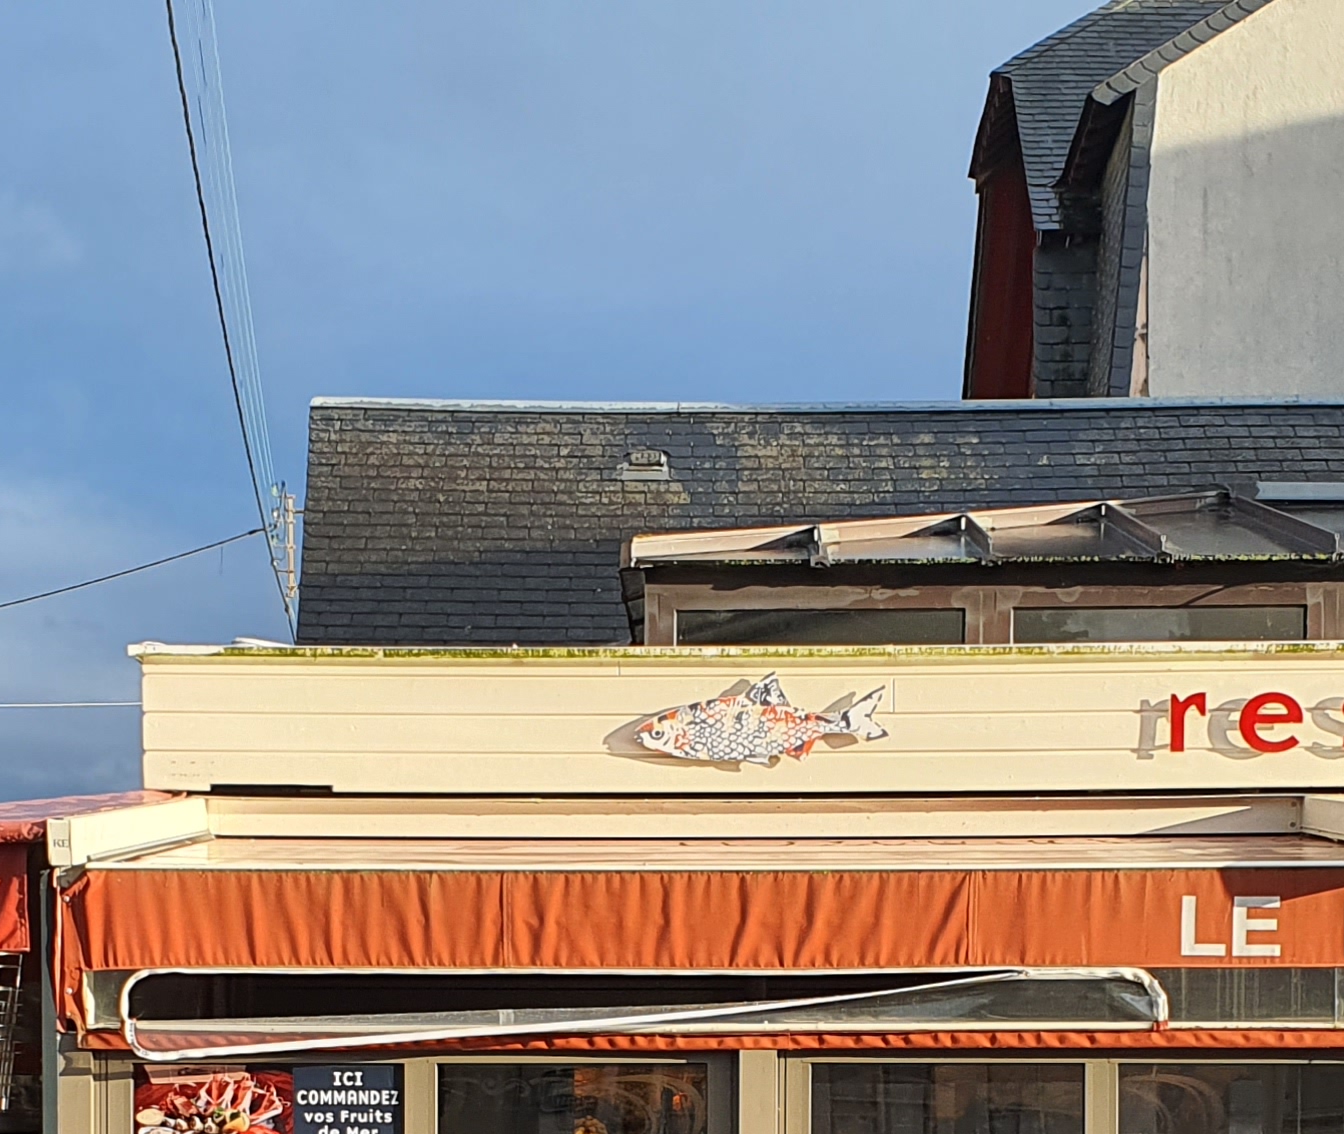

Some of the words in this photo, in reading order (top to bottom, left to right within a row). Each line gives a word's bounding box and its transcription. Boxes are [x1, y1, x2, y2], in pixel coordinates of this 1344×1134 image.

[1181, 895, 1282, 957] LE
[333, 1072, 363, 1086] ICI
[297, 1090, 399, 1105] COMMANDEZ
[304, 1112, 334, 1123] vos
[340, 1109, 393, 1123] Fruits
